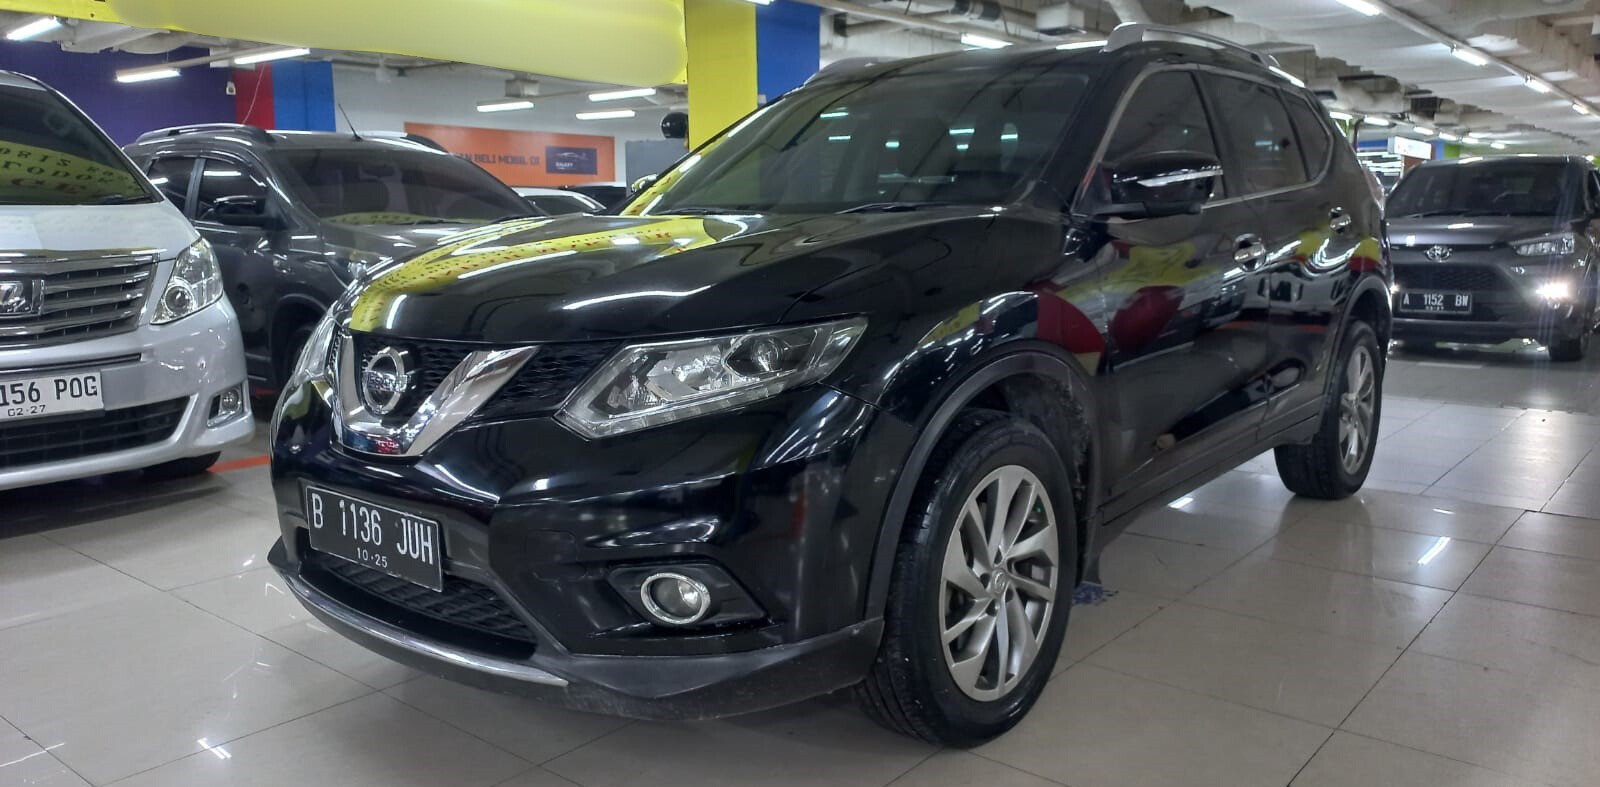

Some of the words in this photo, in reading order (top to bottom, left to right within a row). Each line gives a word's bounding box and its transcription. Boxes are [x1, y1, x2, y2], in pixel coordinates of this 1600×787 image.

[1403, 292, 1410, 305] A
[1423, 293, 1444, 306] 1152
[54, 375, 98, 400] POG
[311, 493, 323, 529] B
[339, 499, 382, 546] 1136
[396, 517, 433, 565] JUH
